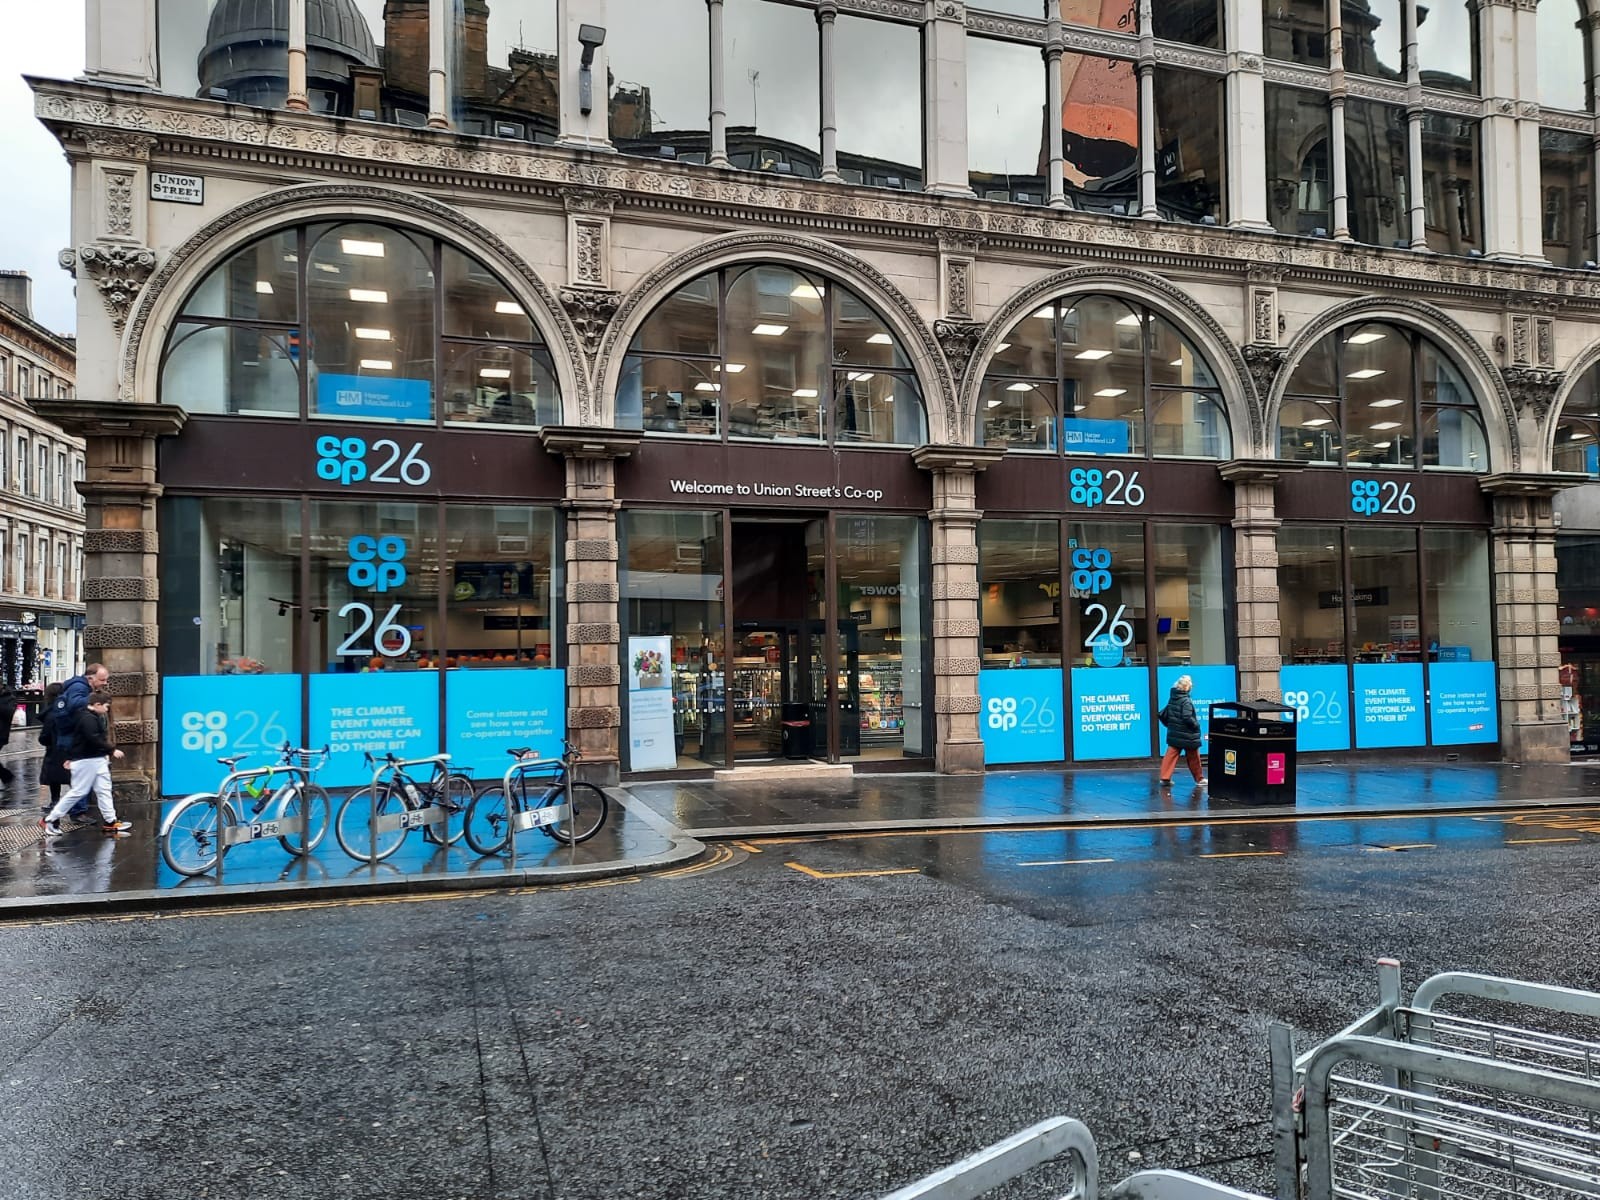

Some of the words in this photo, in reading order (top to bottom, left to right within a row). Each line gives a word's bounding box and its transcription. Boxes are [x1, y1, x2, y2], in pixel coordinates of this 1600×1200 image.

[158, 175, 196, 186] UNION
[153, 184, 200, 197] STREET
[369, 439, 431, 486] 26
[670, 480, 733, 494] Welcome
[737, 484, 750, 495] to
[754, 483, 791, 496] Union
[795, 485, 841, 498] Street's
[844, 486, 883, 501] Co-op
[1105, 469, 1145, 506] 26
[1381, 481, 1416, 515] 26
[336, 602, 411, 657] 26
[1084, 603, 1133, 647] 26
[1081, 695, 1096, 703] THE
[1097, 694, 1130, 702] CLIMATE
[1312, 690, 1341, 719] 26
[331, 708, 353, 716] THE
[356, 706, 405, 716] CLIMATE
[497, 709, 528, 717] instore
[531, 708, 548, 716] and
[1021, 697, 1055, 727] 26
[331, 719, 368, 728] EVENT
[372, 717, 414, 727] WHERE
[1082, 714, 1122, 722] EVERYONE
[232, 710, 288, 749] 26
[461, 730, 511, 739] co-operate
[514, 728, 552, 737] together
[1082, 724, 1094, 732] DO
[1096, 723, 1118, 731] THEIR
[1119, 722, 1131, 730] BIT
[331, 730, 393, 740] EVERYONE
[395, 729, 421, 738] CAN
[331, 743, 350, 752] DO
[352, 742, 386, 751] THEIR
[389, 741, 406, 750] BIT
[401, 814, 409, 827] P
[251, 825, 261, 839] P
